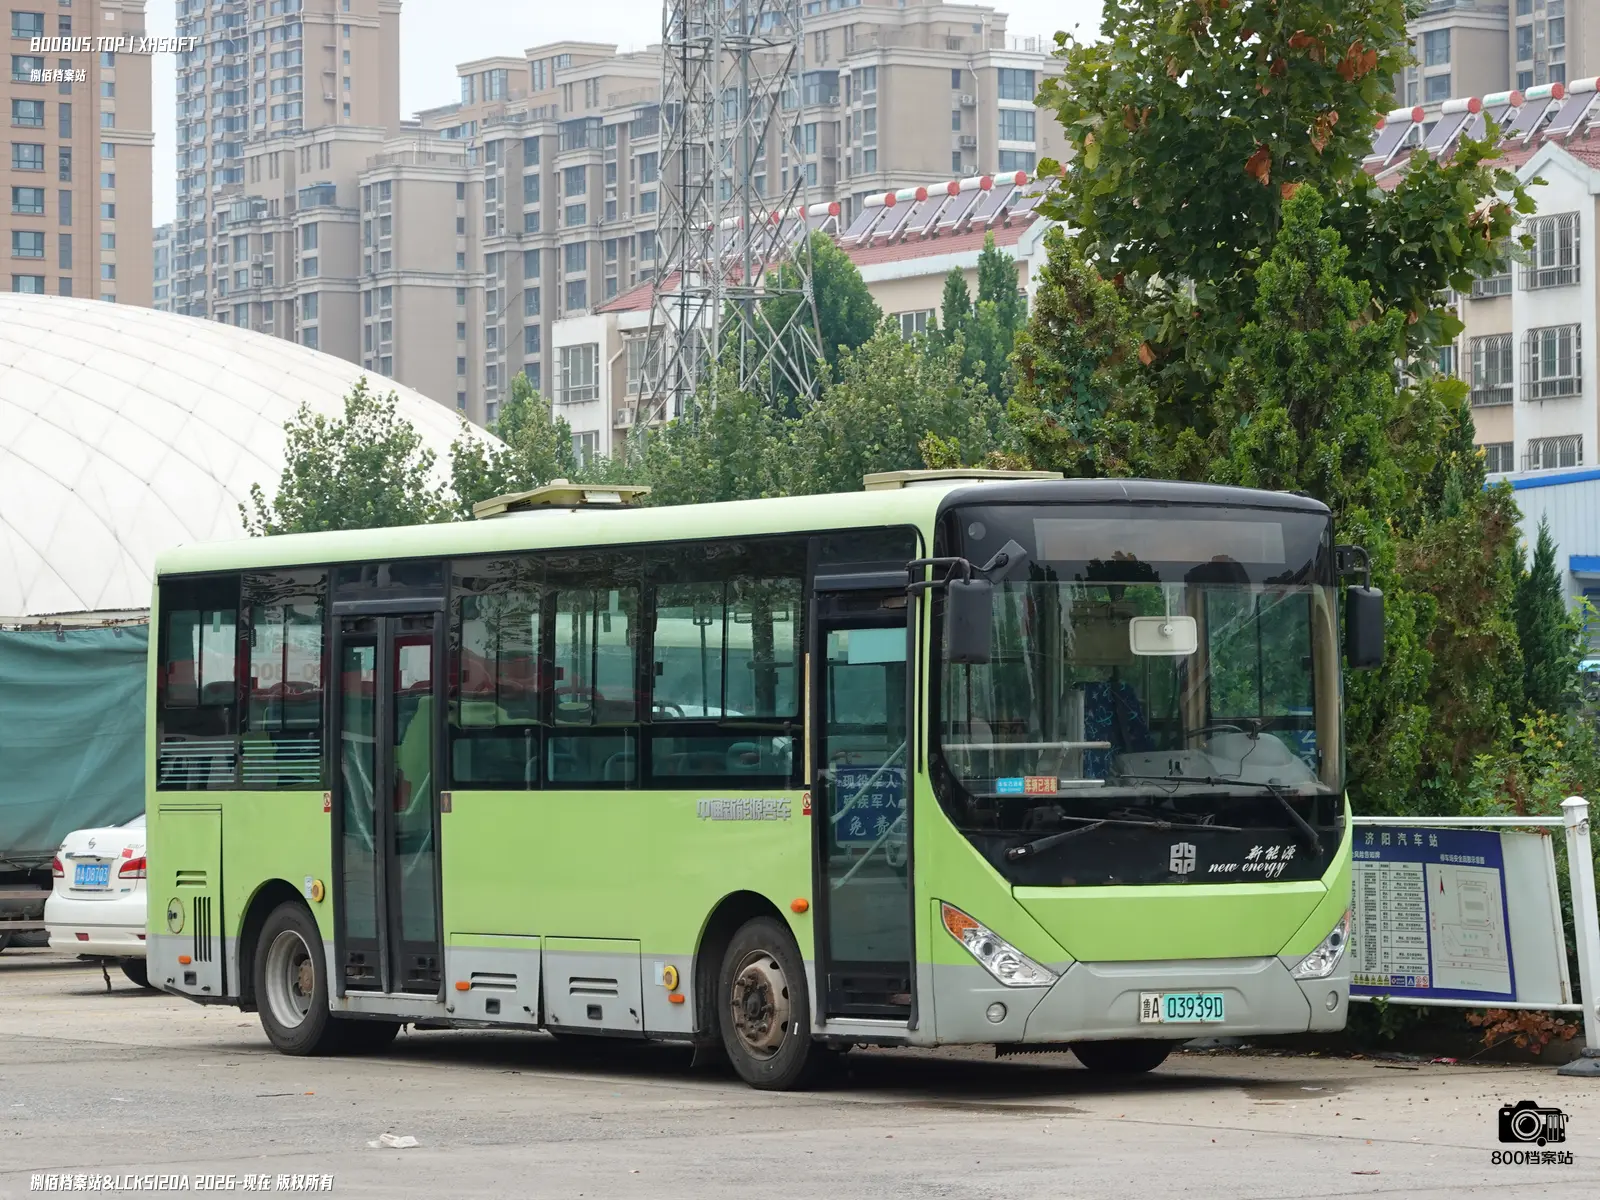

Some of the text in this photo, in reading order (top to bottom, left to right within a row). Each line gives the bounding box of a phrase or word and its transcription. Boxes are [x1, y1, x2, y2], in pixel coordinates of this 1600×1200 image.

[696, 797, 791, 821] 中通新能源客车
[1364, 831, 1439, 848] 济阳汽车站
[1245, 844, 1297, 861] 新能源
[1208, 859, 1288, 878] new energy
